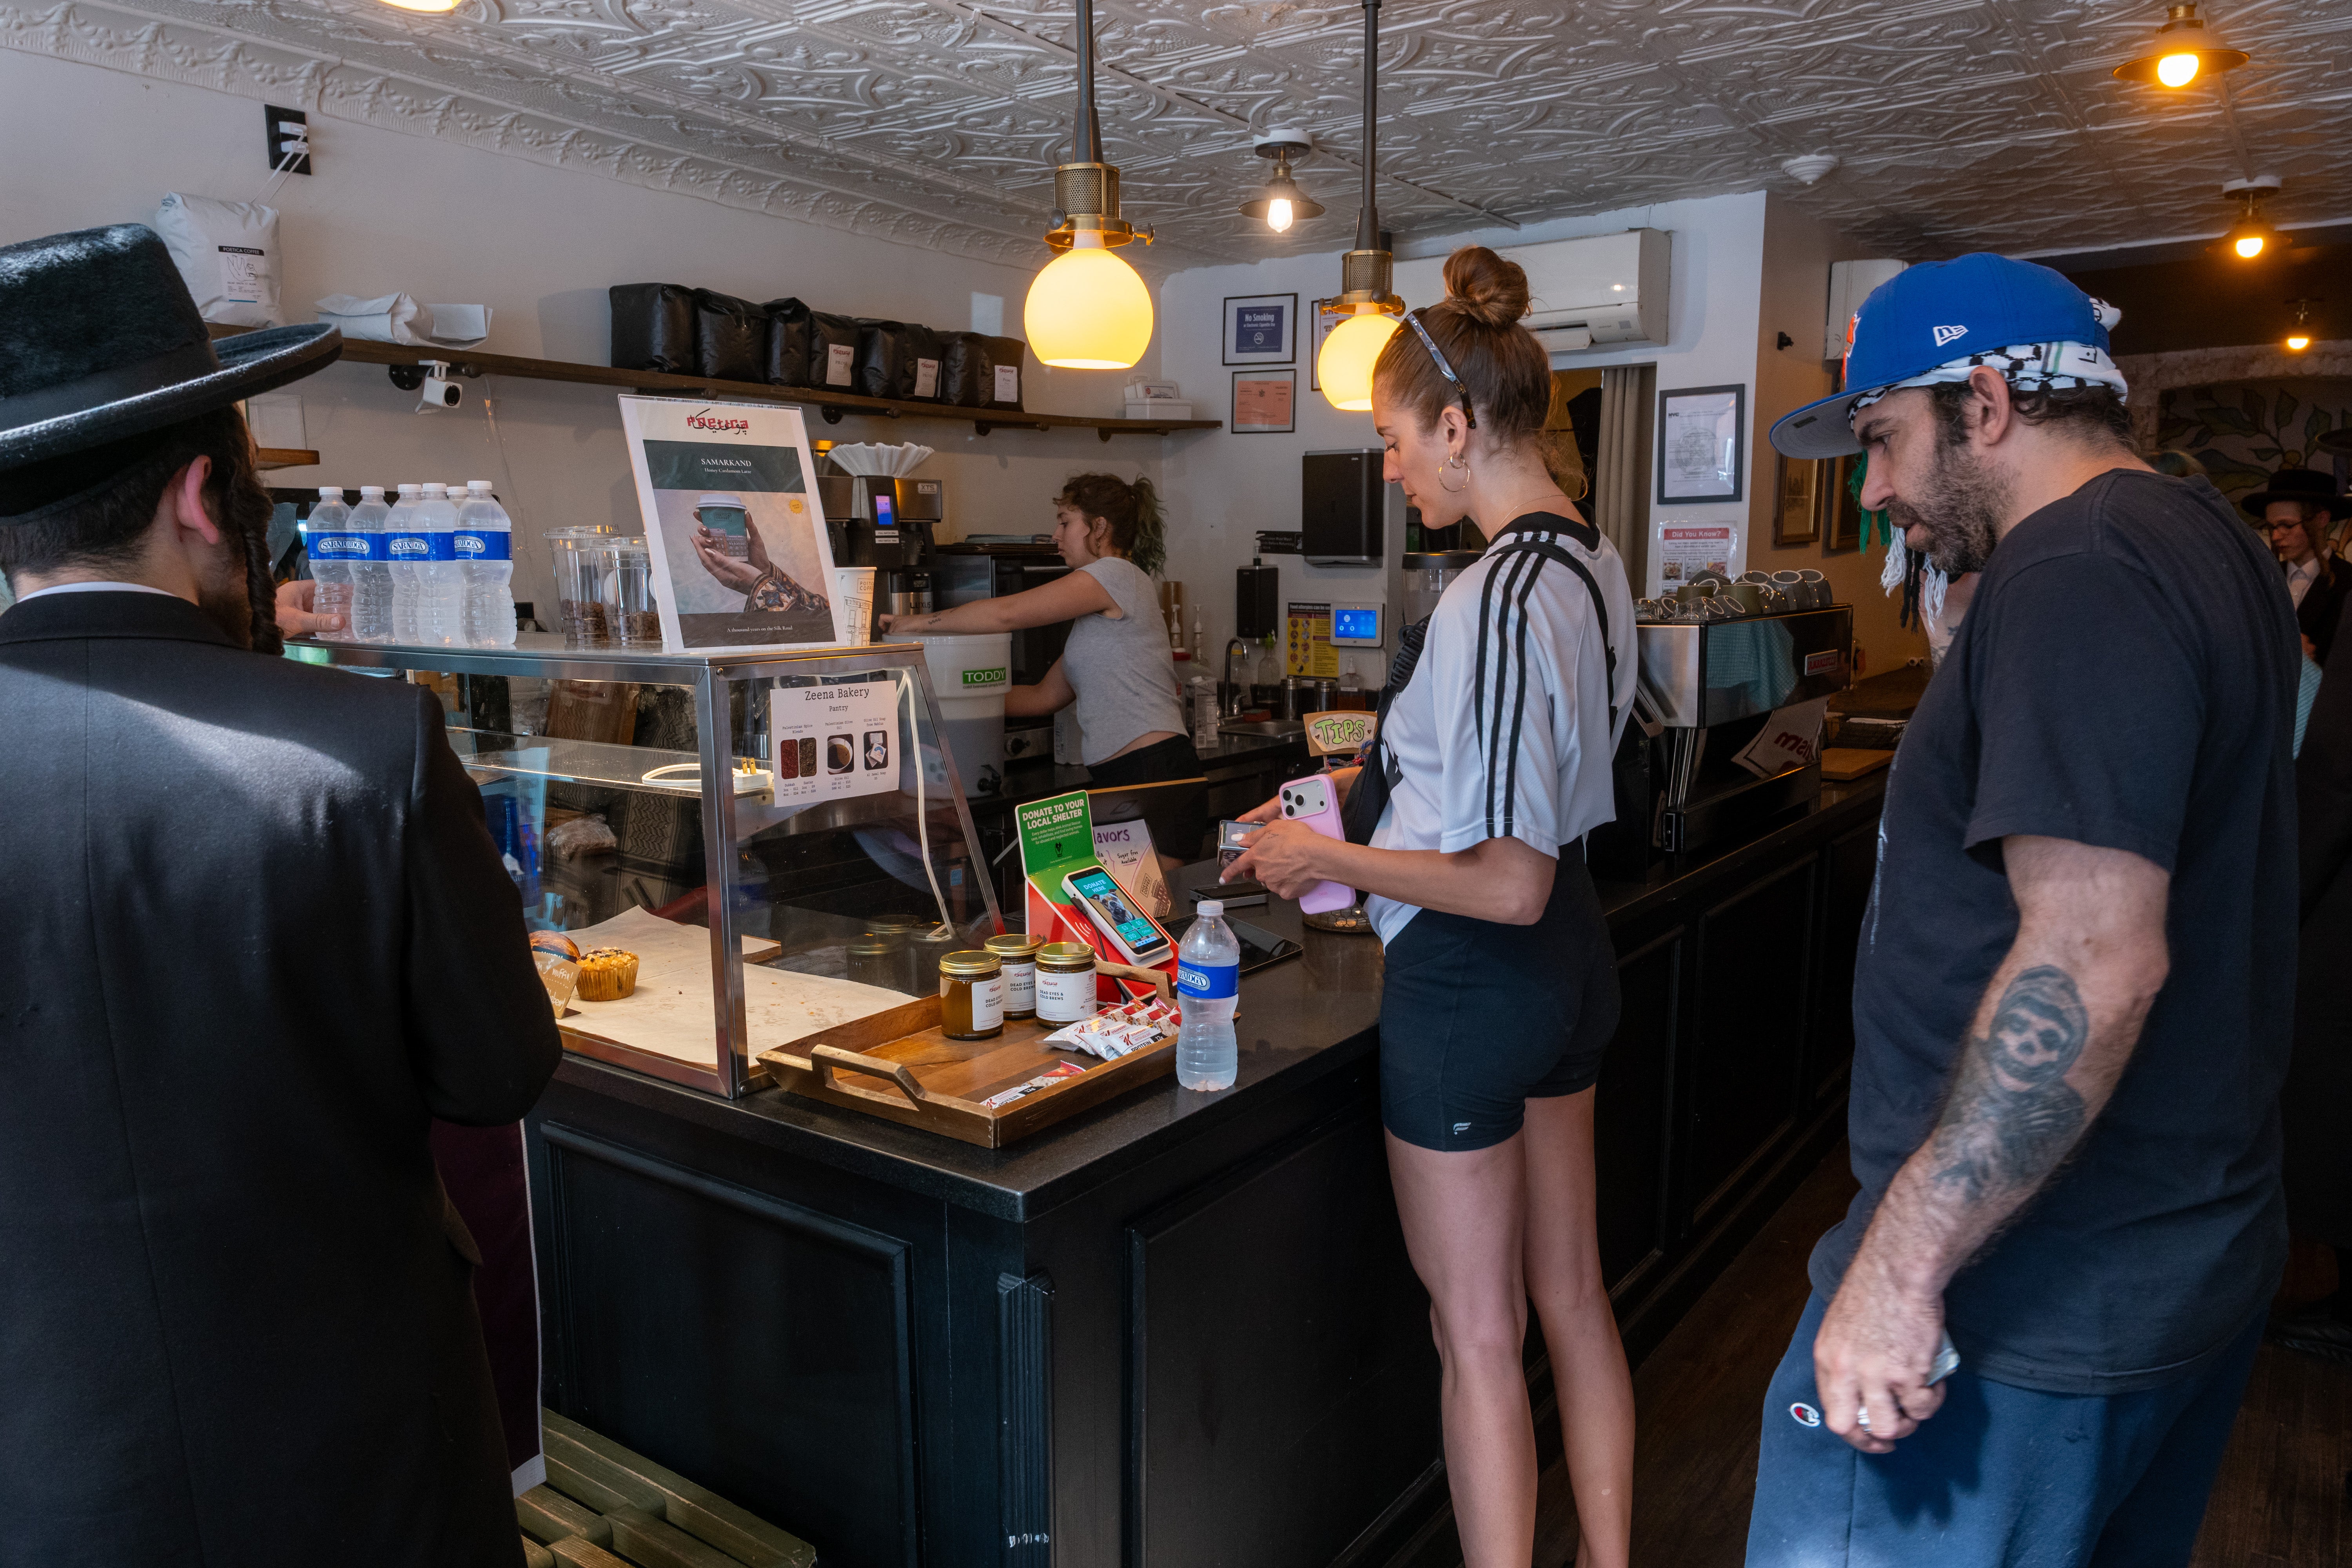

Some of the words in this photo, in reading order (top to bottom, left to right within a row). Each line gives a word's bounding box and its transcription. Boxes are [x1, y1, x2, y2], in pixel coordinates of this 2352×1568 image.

[1253, 313, 1274, 322] Smoking
[701, 458, 751, 466] SAMARKAND
[455, 539, 479, 548] ARATOGA
[965, 670, 1005, 682] TODDY
[805, 691, 834, 701] Zeena
[838, 688, 869, 698] Bakery
[1315, 719, 1365, 744] TIPS
[1022, 806, 1053, 821] DONATE
[1054, 804, 1064, 813] TO
[1065, 799, 1085, 810] YOUR
[1027, 817, 1051, 829] LOCAL
[1053, 809, 1082, 823] SHELTER
[1093, 829, 1130, 844] lavors
[1083, 879, 1107, 890] DONATE
[1178, 971, 1204, 985] ARATOGA
[1131, 1028, 1147, 1037] STRAWBERRY
